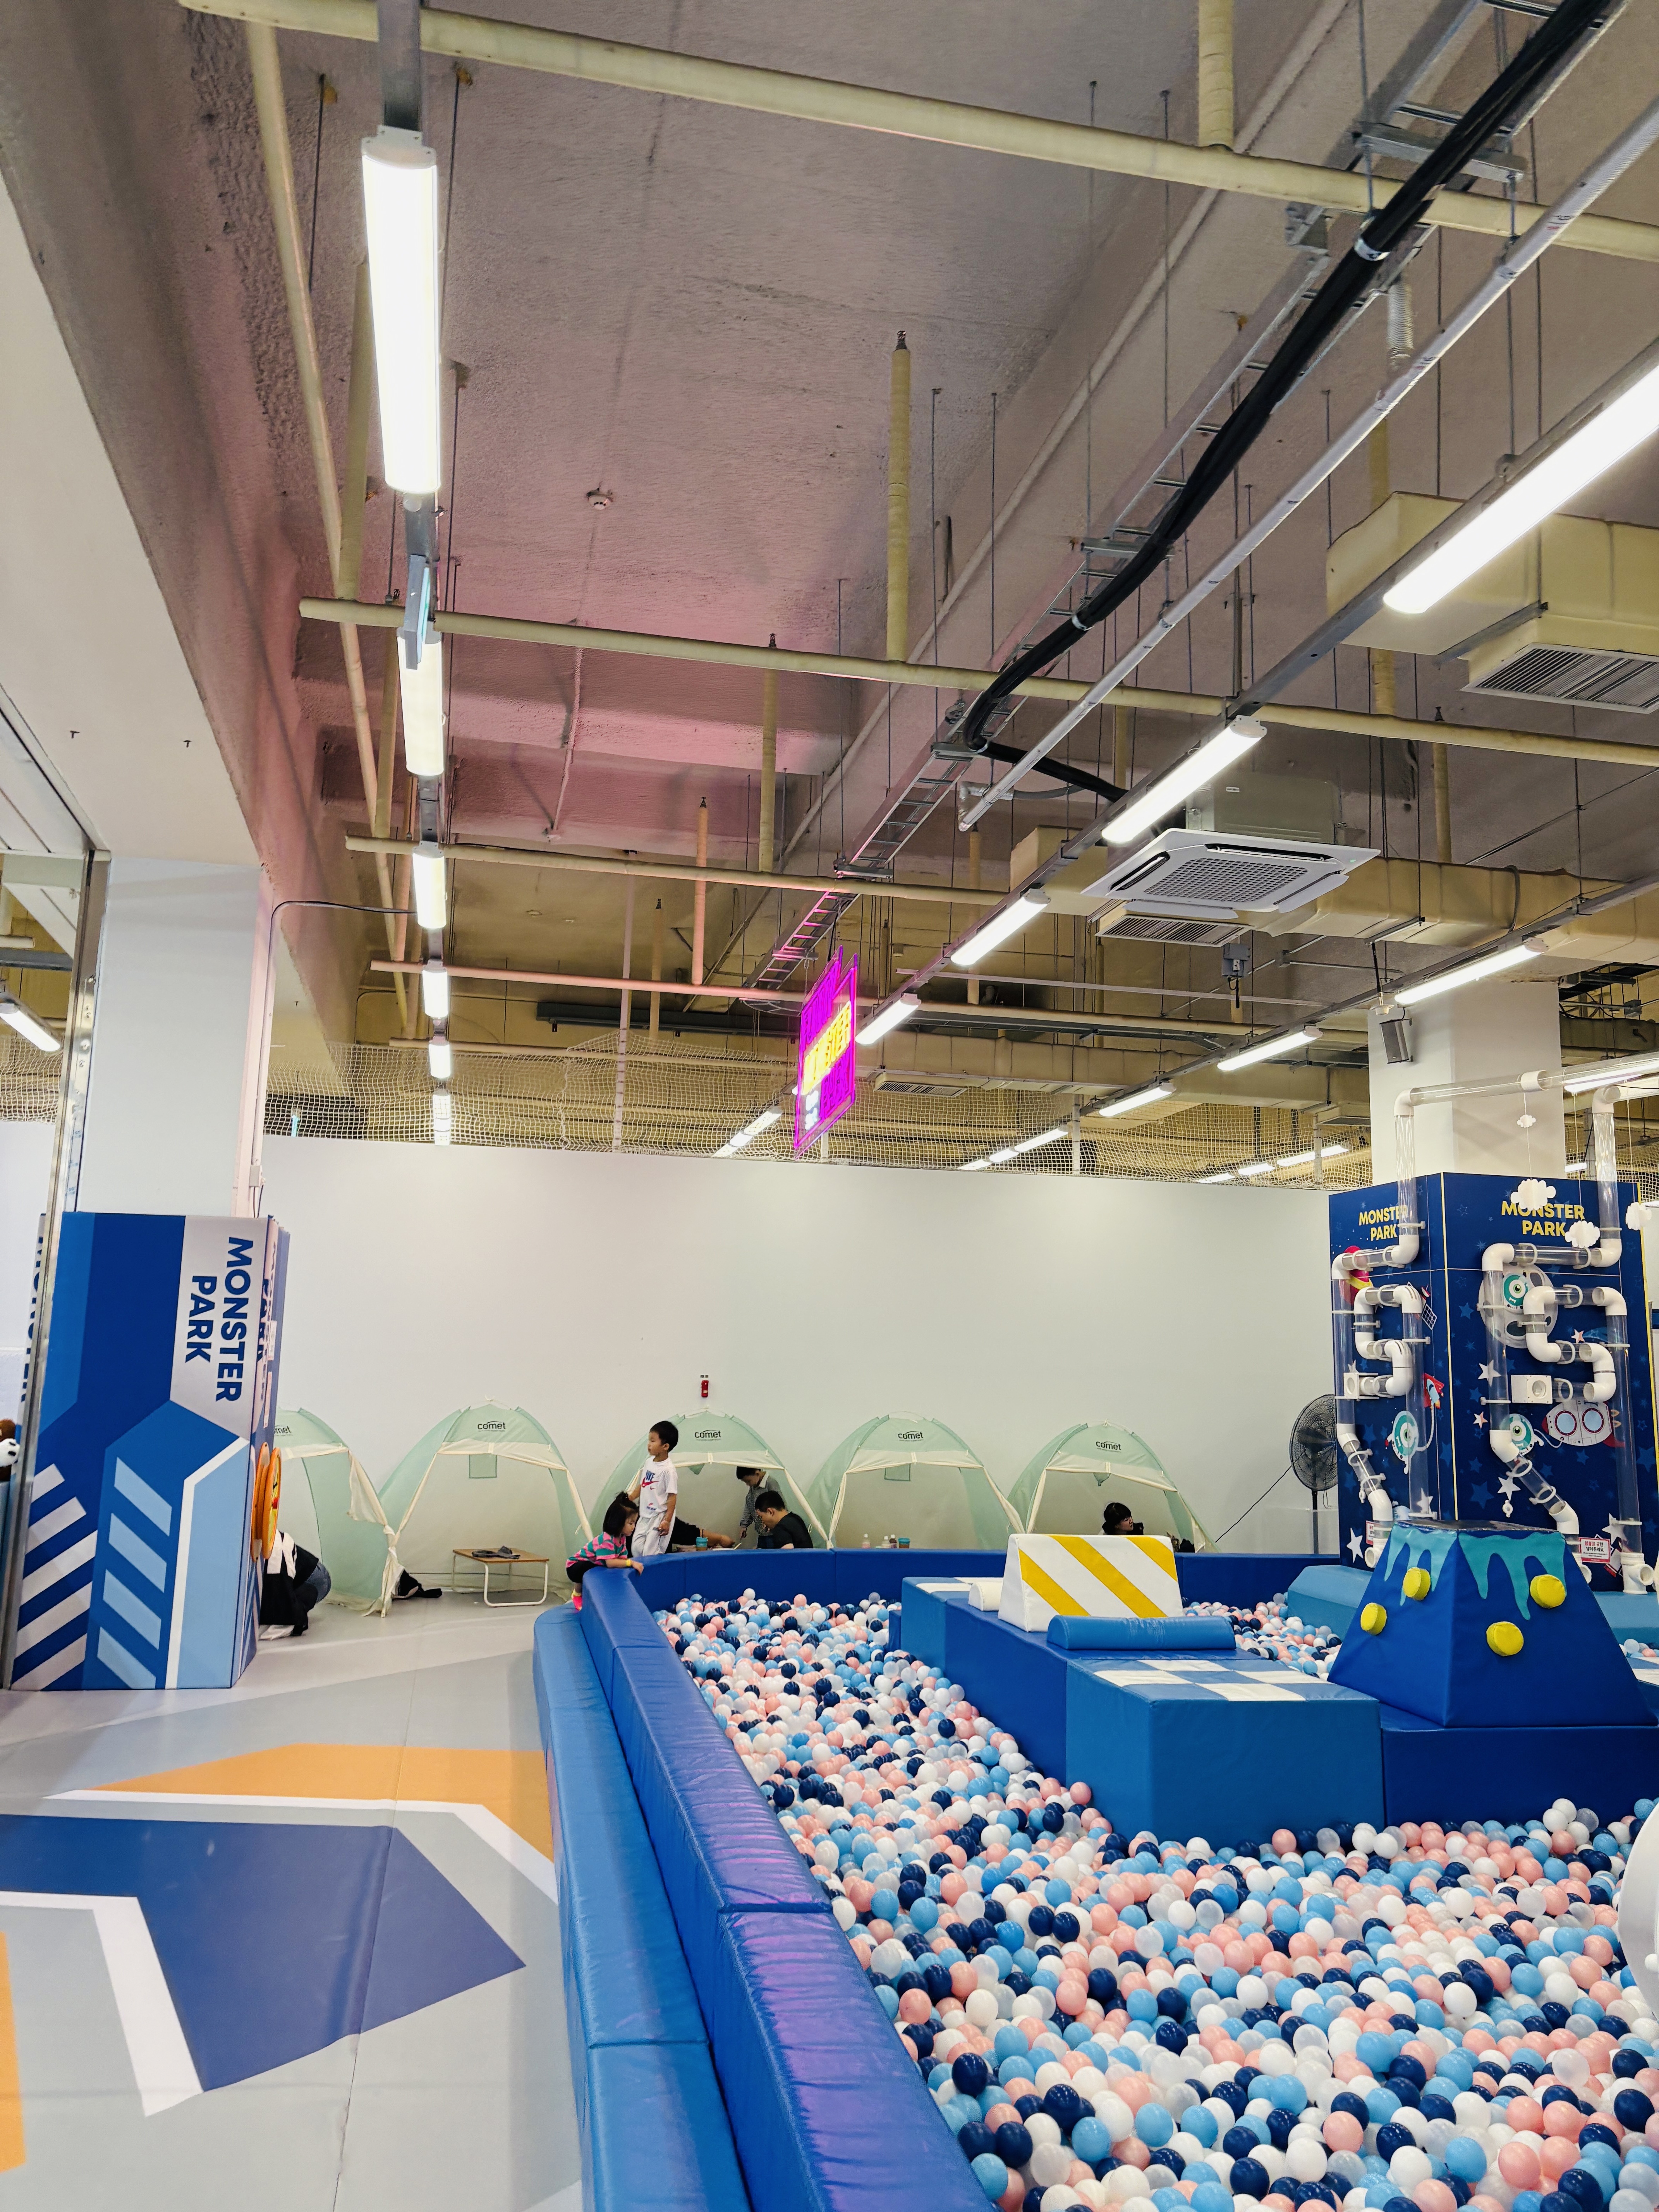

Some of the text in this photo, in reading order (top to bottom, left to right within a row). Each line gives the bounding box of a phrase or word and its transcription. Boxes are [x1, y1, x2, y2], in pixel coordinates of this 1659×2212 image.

[1501, 1201, 1585, 1219] MONSTER
[1370, 1224, 1398, 1241] PARK
[1522, 1220, 1566, 1236] PARK
[185, 1276, 217, 1364] PARK
[216, 1237, 253, 1401] MONSTER
[275, 1425, 291, 1434] met
[477, 1421, 505, 1429] comet
[694, 1430, 721, 1438] comet
[898, 1431, 923, 1439] comet
[1096, 1441, 1121, 1450] comet
